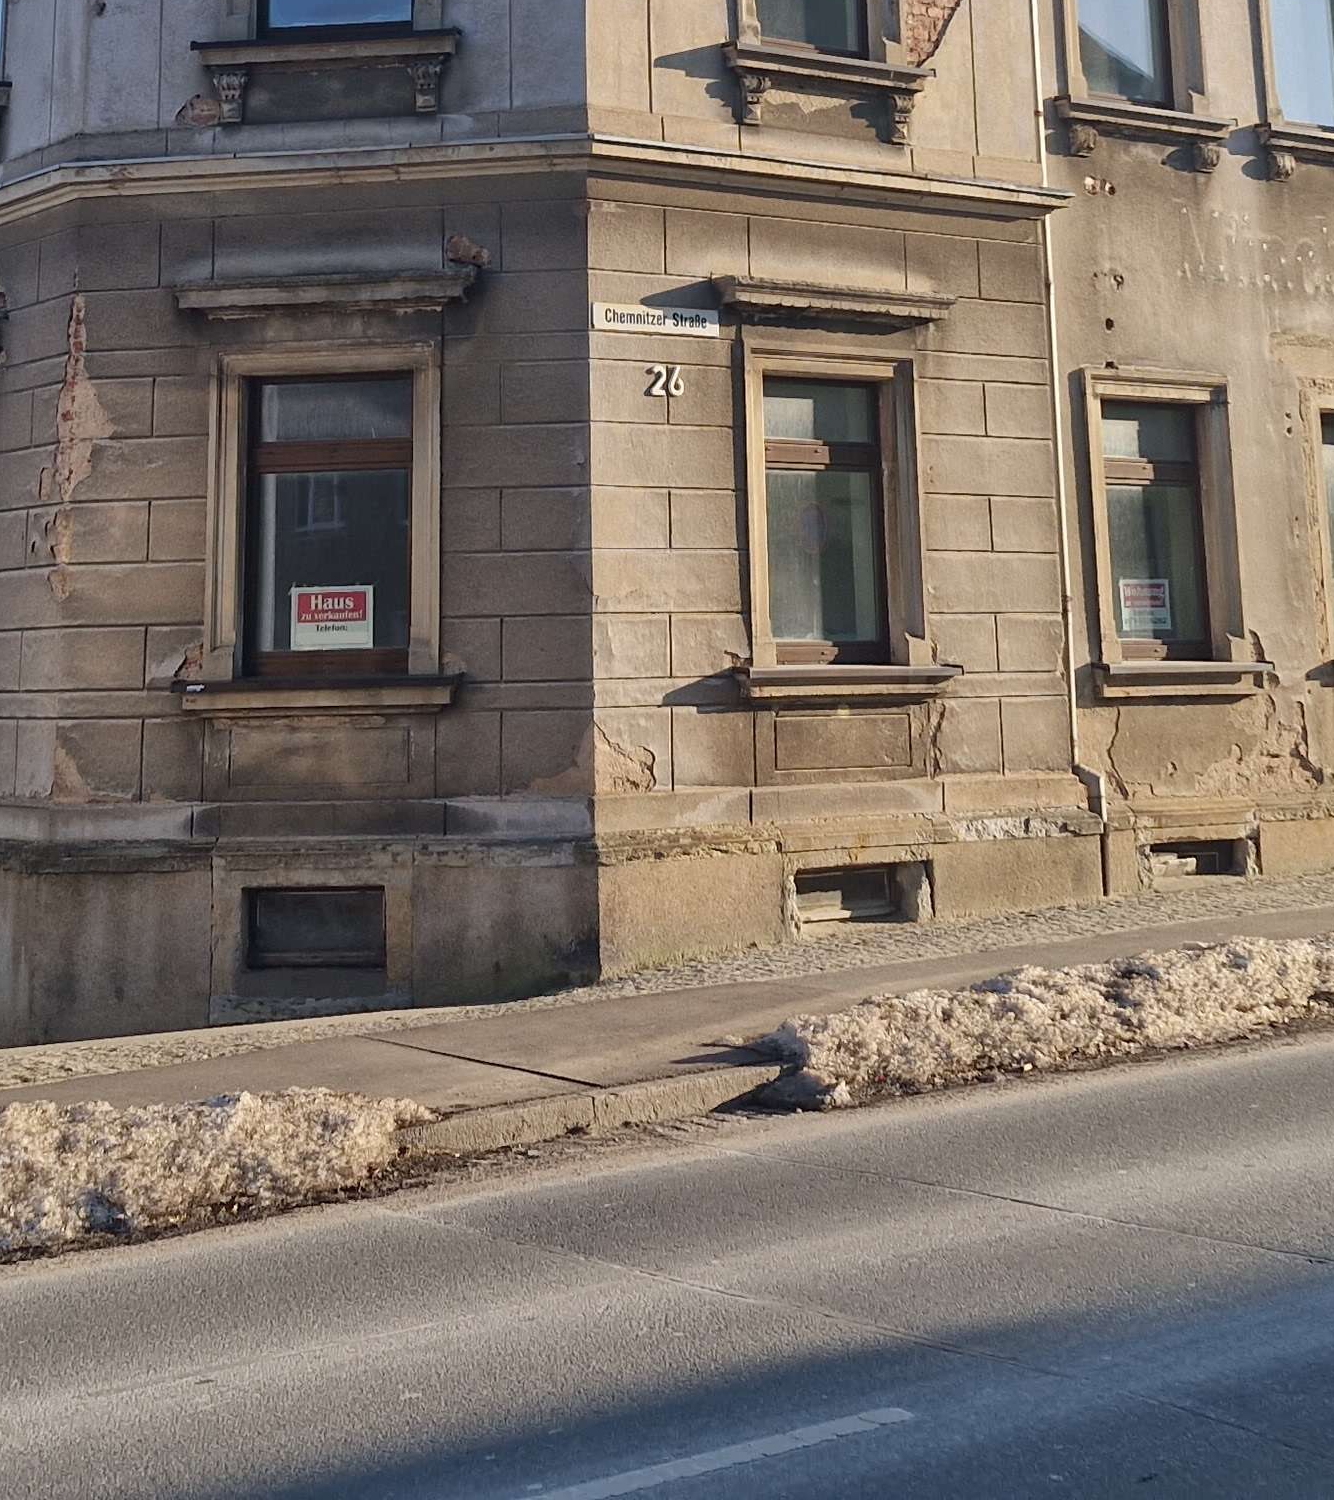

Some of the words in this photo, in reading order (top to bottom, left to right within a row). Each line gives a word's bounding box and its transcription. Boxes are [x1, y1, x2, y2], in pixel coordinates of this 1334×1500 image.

[604, 307, 667, 326] Chemnitzer
[672, 312, 707, 328] Straße
[645, 364, 685, 397] 26
[310, 594, 354, 611] Haus
[300, 612, 312, 621] zu
[314, 609, 363, 621] verkaufen!
